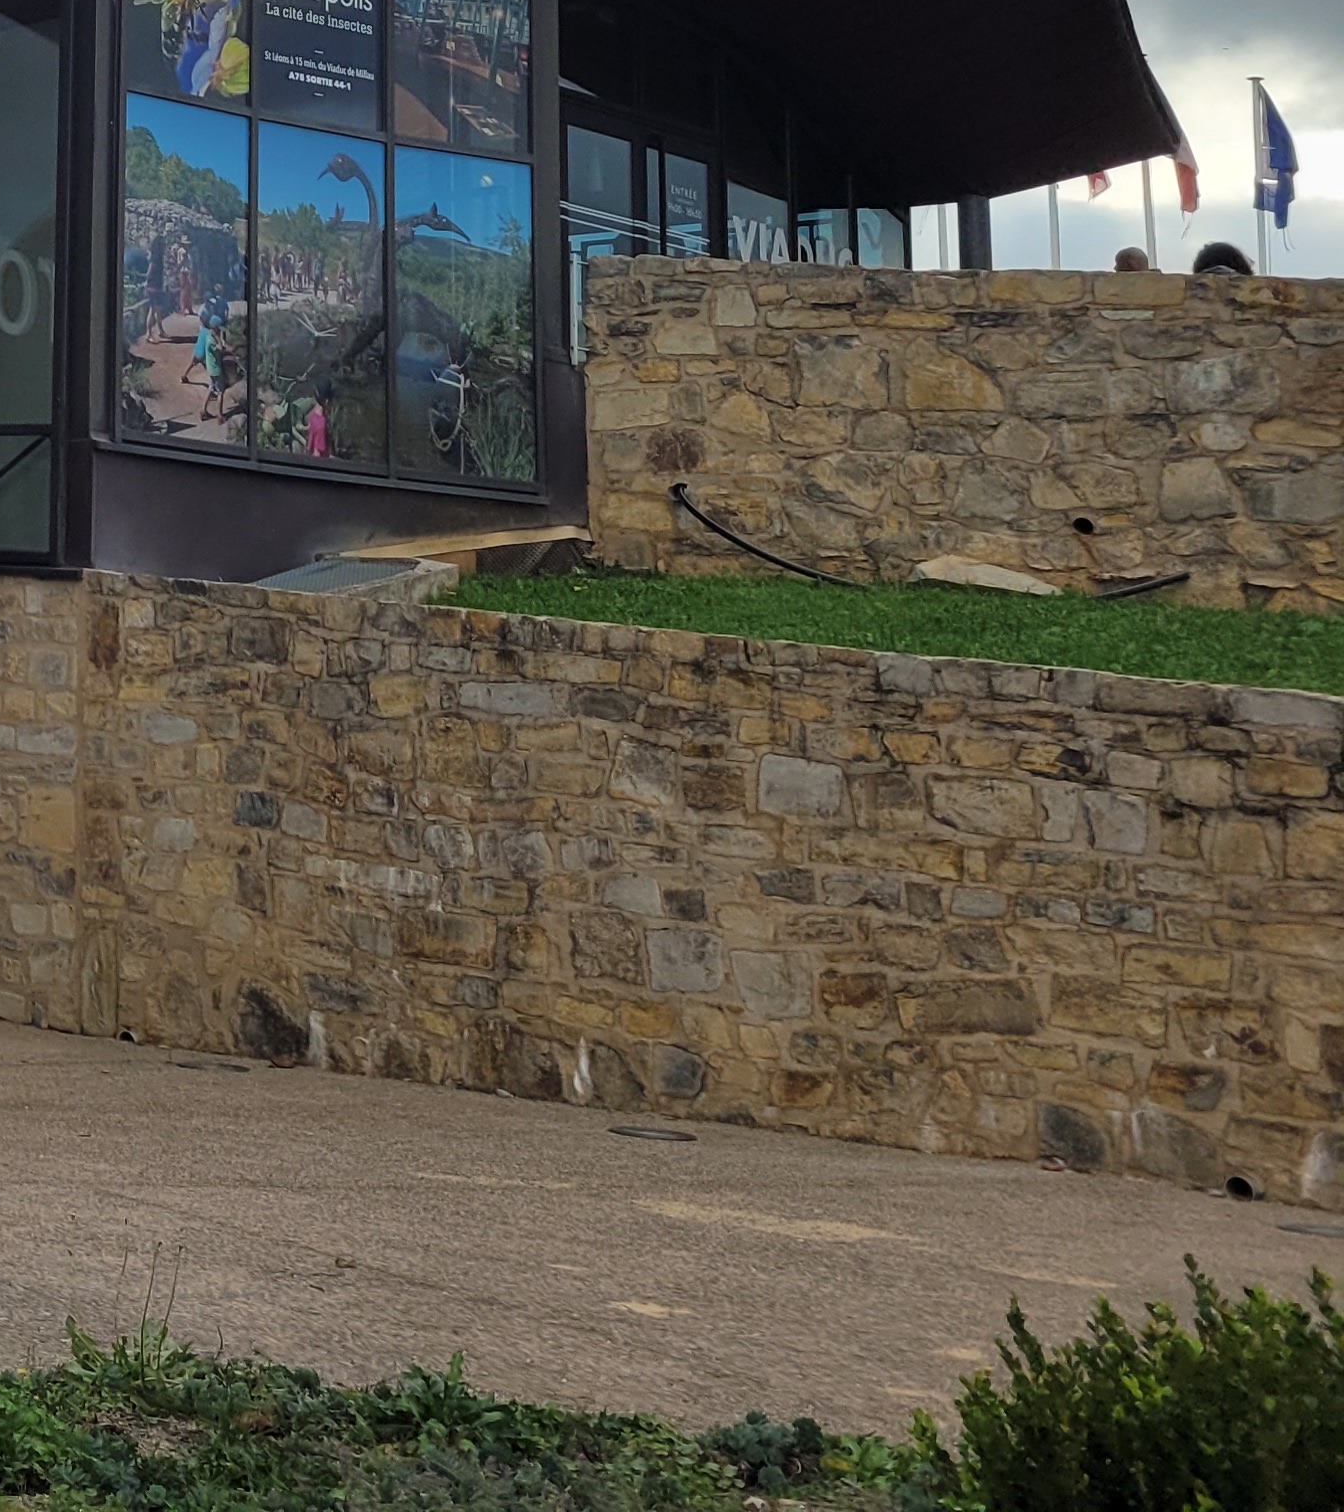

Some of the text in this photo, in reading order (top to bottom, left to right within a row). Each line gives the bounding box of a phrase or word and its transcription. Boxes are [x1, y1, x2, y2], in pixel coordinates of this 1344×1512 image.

[266, 3, 373, 35] La cité des insectes
[264, 50, 271, 60] St
[272, 52, 289, 63] Léons
[290, 55, 294, 65] à
[295, 56, 303, 67] 15
[318, 61, 326, 72] du
[326, 62, 347, 75] Viaduc
[347, 67, 355, 77] de
[356, 68, 375, 81] Millau
[306, 75, 333, 87] SORTIE
[334, 79, 351, 91] 44-1
